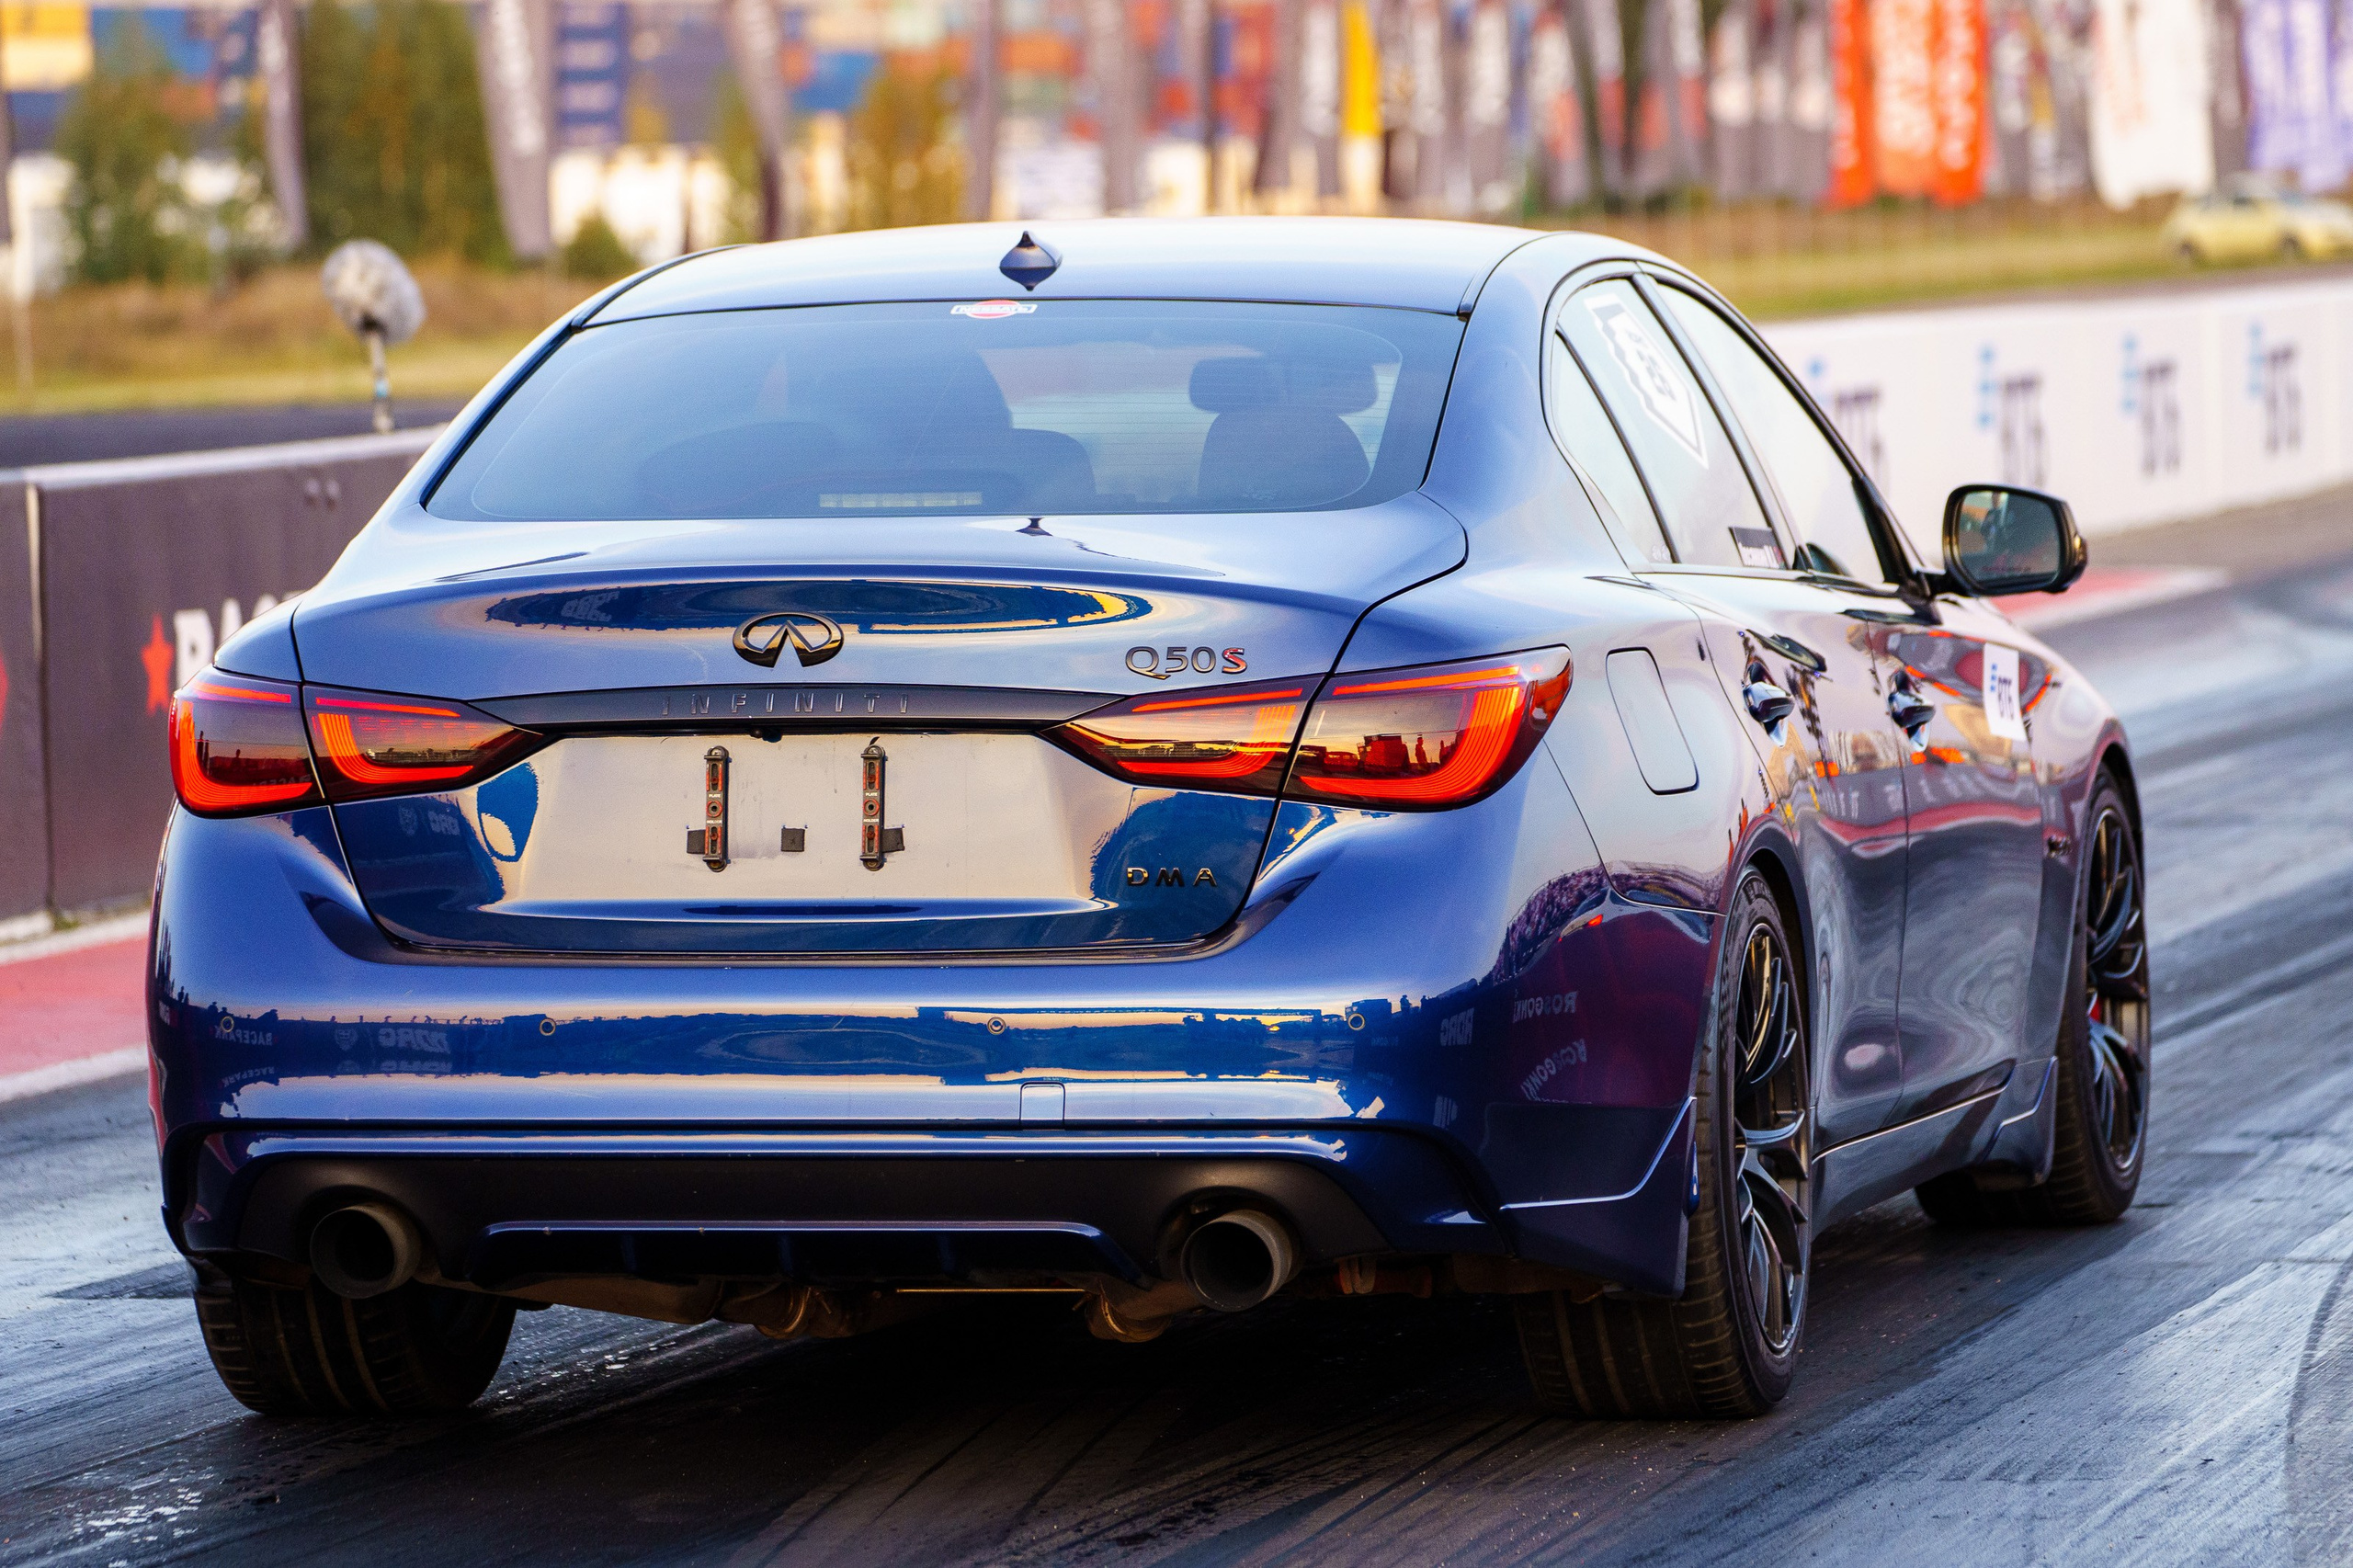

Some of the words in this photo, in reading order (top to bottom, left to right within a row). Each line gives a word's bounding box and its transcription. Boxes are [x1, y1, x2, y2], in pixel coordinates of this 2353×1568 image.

[1125, 646, 1247, 680] Q50S
[662, 692, 908, 715] INFINITI
[1127, 867, 1218, 887] DMA
